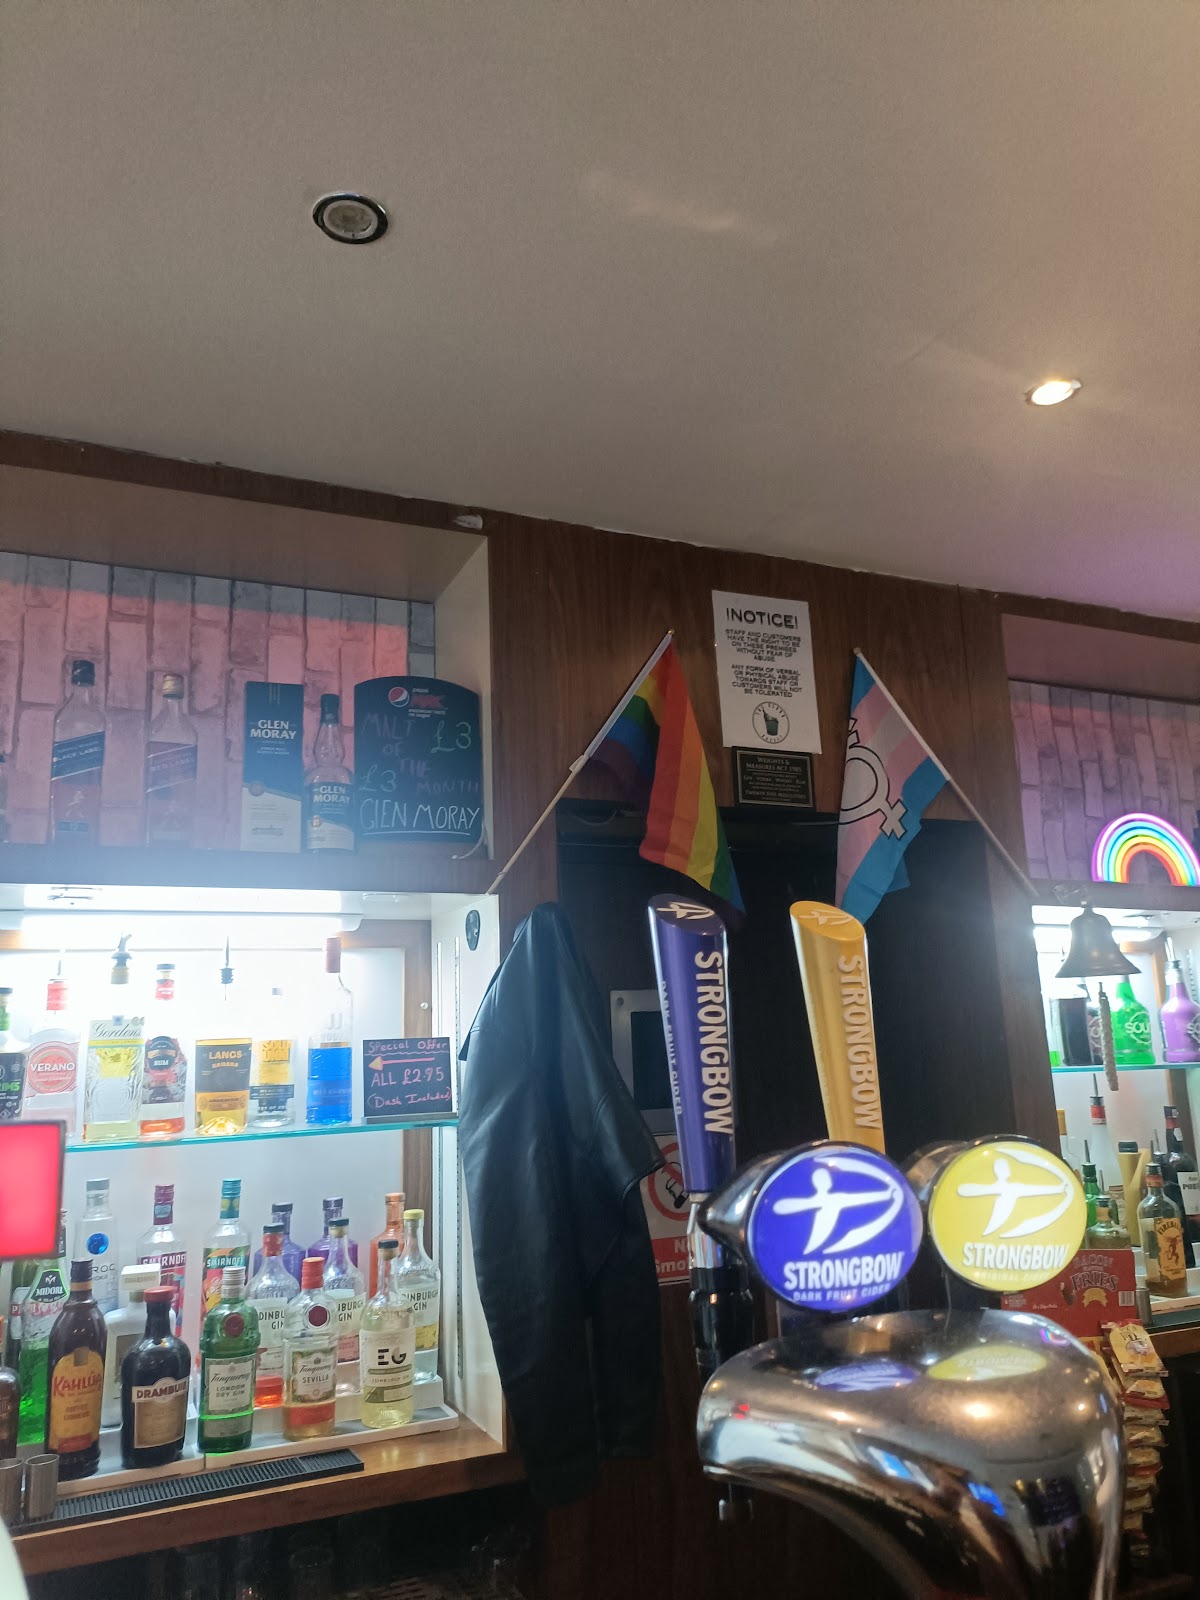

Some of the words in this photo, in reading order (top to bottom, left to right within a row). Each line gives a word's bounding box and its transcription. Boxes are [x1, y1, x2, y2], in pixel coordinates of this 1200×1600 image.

[725, 628, 746, 636] STAFF
[762, 632, 801, 642] CUSTOMERS
[736, 647, 765, 655] WITHOUT
[765, 644, 798, 653] PREMISES
[753, 654, 776, 662] ABUSE
[745, 671, 777, 680] PHYSICAL
[776, 668, 800, 676] VERBAL
[735, 675, 767, 684] TOWARDS
[731, 681, 772, 690] CUSTOMERS
[755, 689, 793, 698] TOLERATED
[257, 719, 290, 730] GLEN
[250, 729, 297, 740] MORAY
[431, 720, 472, 753] £3
[358, 763, 397, 792] £3
[319, 785, 346, 795] GLEN
[416, 779, 479, 796] MONTH
[313, 793, 351, 805] MORAY
[412, 804, 480, 830] MORAY
[417, 1039, 447, 1050] Offer
[694, 950, 734, 1135] STRONGBOW
[837, 953, 882, 1131] STRONGBOW
[30, 1062, 76, 1072] VERANO
[370, 1071, 397, 1088] ALL
[402, 1066, 445, 1086] £2.95
[962, 1241, 1069, 1270] STRONGBOW
[206, 1256, 246, 1268] SMIRNOFF
[784, 1251, 905, 1291] STRONGBOW
[1069, 1270, 1119, 1292] FRIES
[35, 1286, 63, 1297] MIDORI
[792, 1291, 822, 1303] DARK
[827, 1289, 858, 1301] FRUIT
[861, 1283, 891, 1298] CIDER
[413, 1301, 428, 1311] GIN
[338, 1311, 353, 1322] GIN
[377, 1347, 407, 1366] EG
[302, 1374, 329, 1384] SEVILLA
[136, 1380, 187, 1399] DRAMBUIE
[216, 1384, 245, 1392] LONDON
